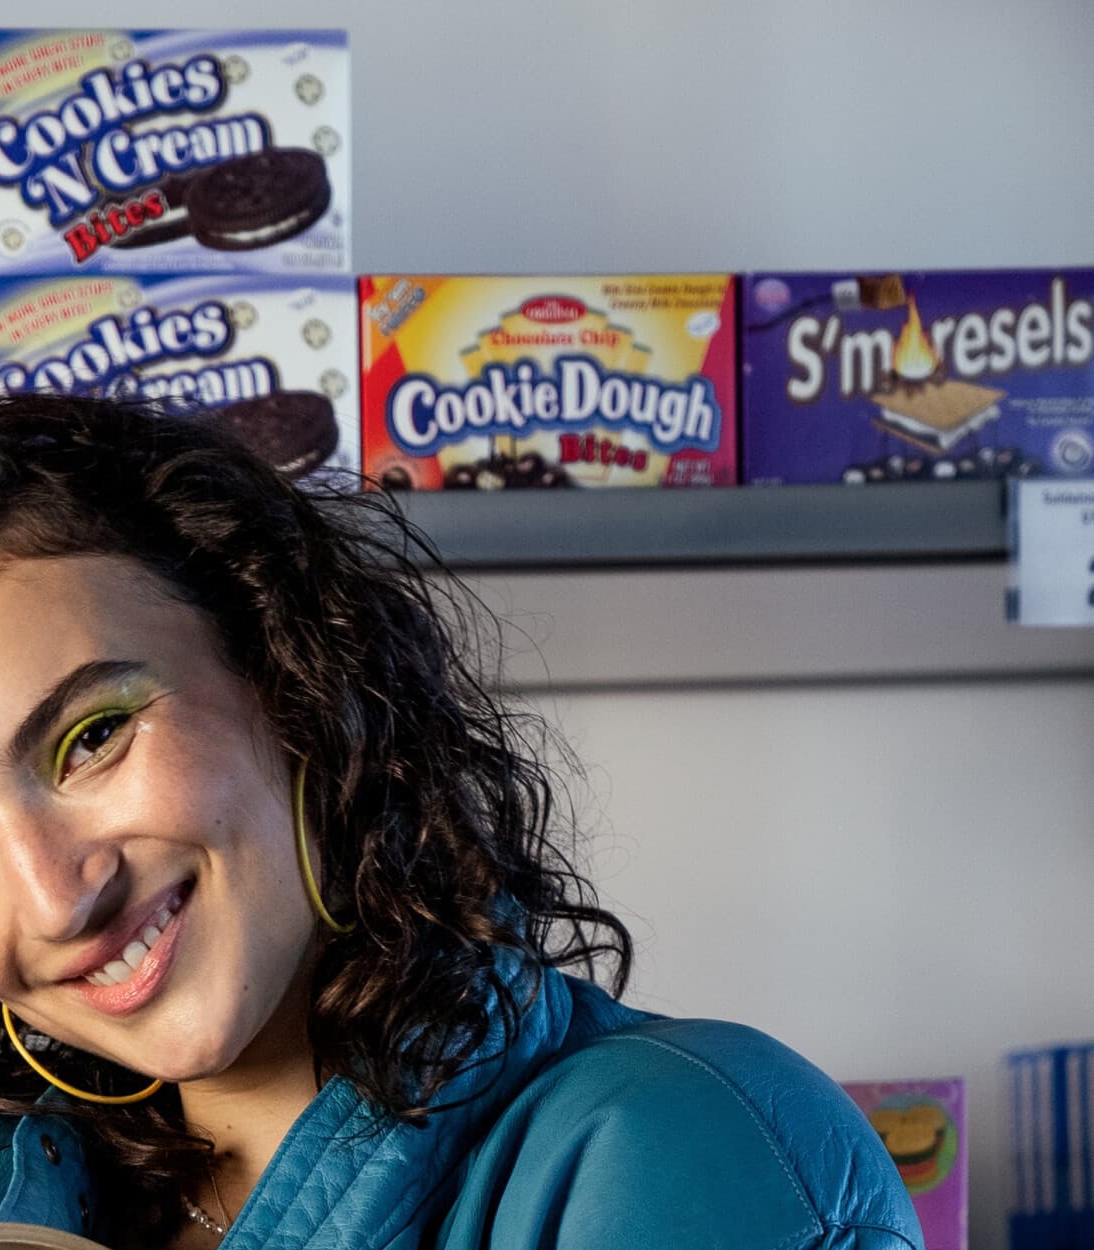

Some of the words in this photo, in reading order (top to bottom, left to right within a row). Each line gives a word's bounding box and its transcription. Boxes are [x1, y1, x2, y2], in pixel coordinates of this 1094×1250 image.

[95, 116, 266, 187] Cream
[63, 192, 166, 262] Bites
[580, 328, 620, 348] Chip
[787, 276, 1092, 401] S'mresels
[559, 434, 649, 471] Bites
